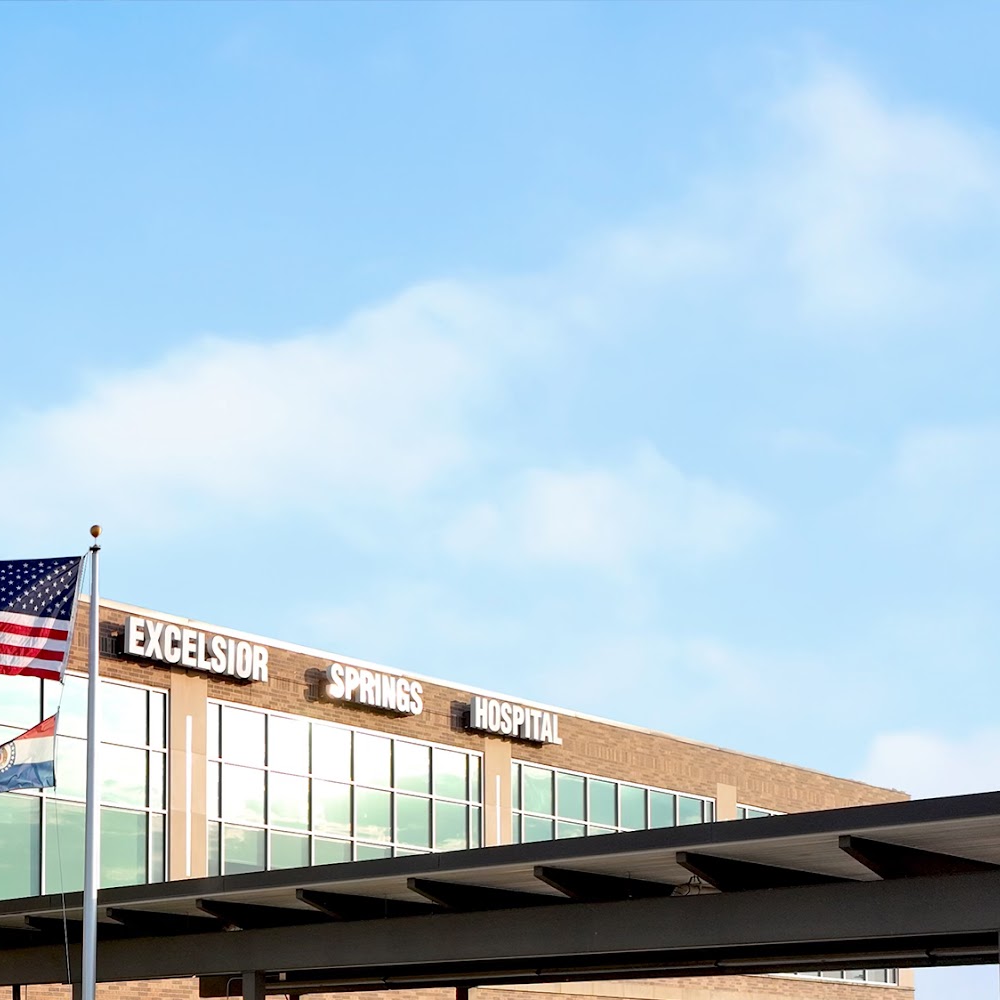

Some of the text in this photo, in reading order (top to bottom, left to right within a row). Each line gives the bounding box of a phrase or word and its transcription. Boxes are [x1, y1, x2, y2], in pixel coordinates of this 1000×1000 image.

[126, 615, 563, 745] EXCELSIOR SPRINGS HOSPITAL
